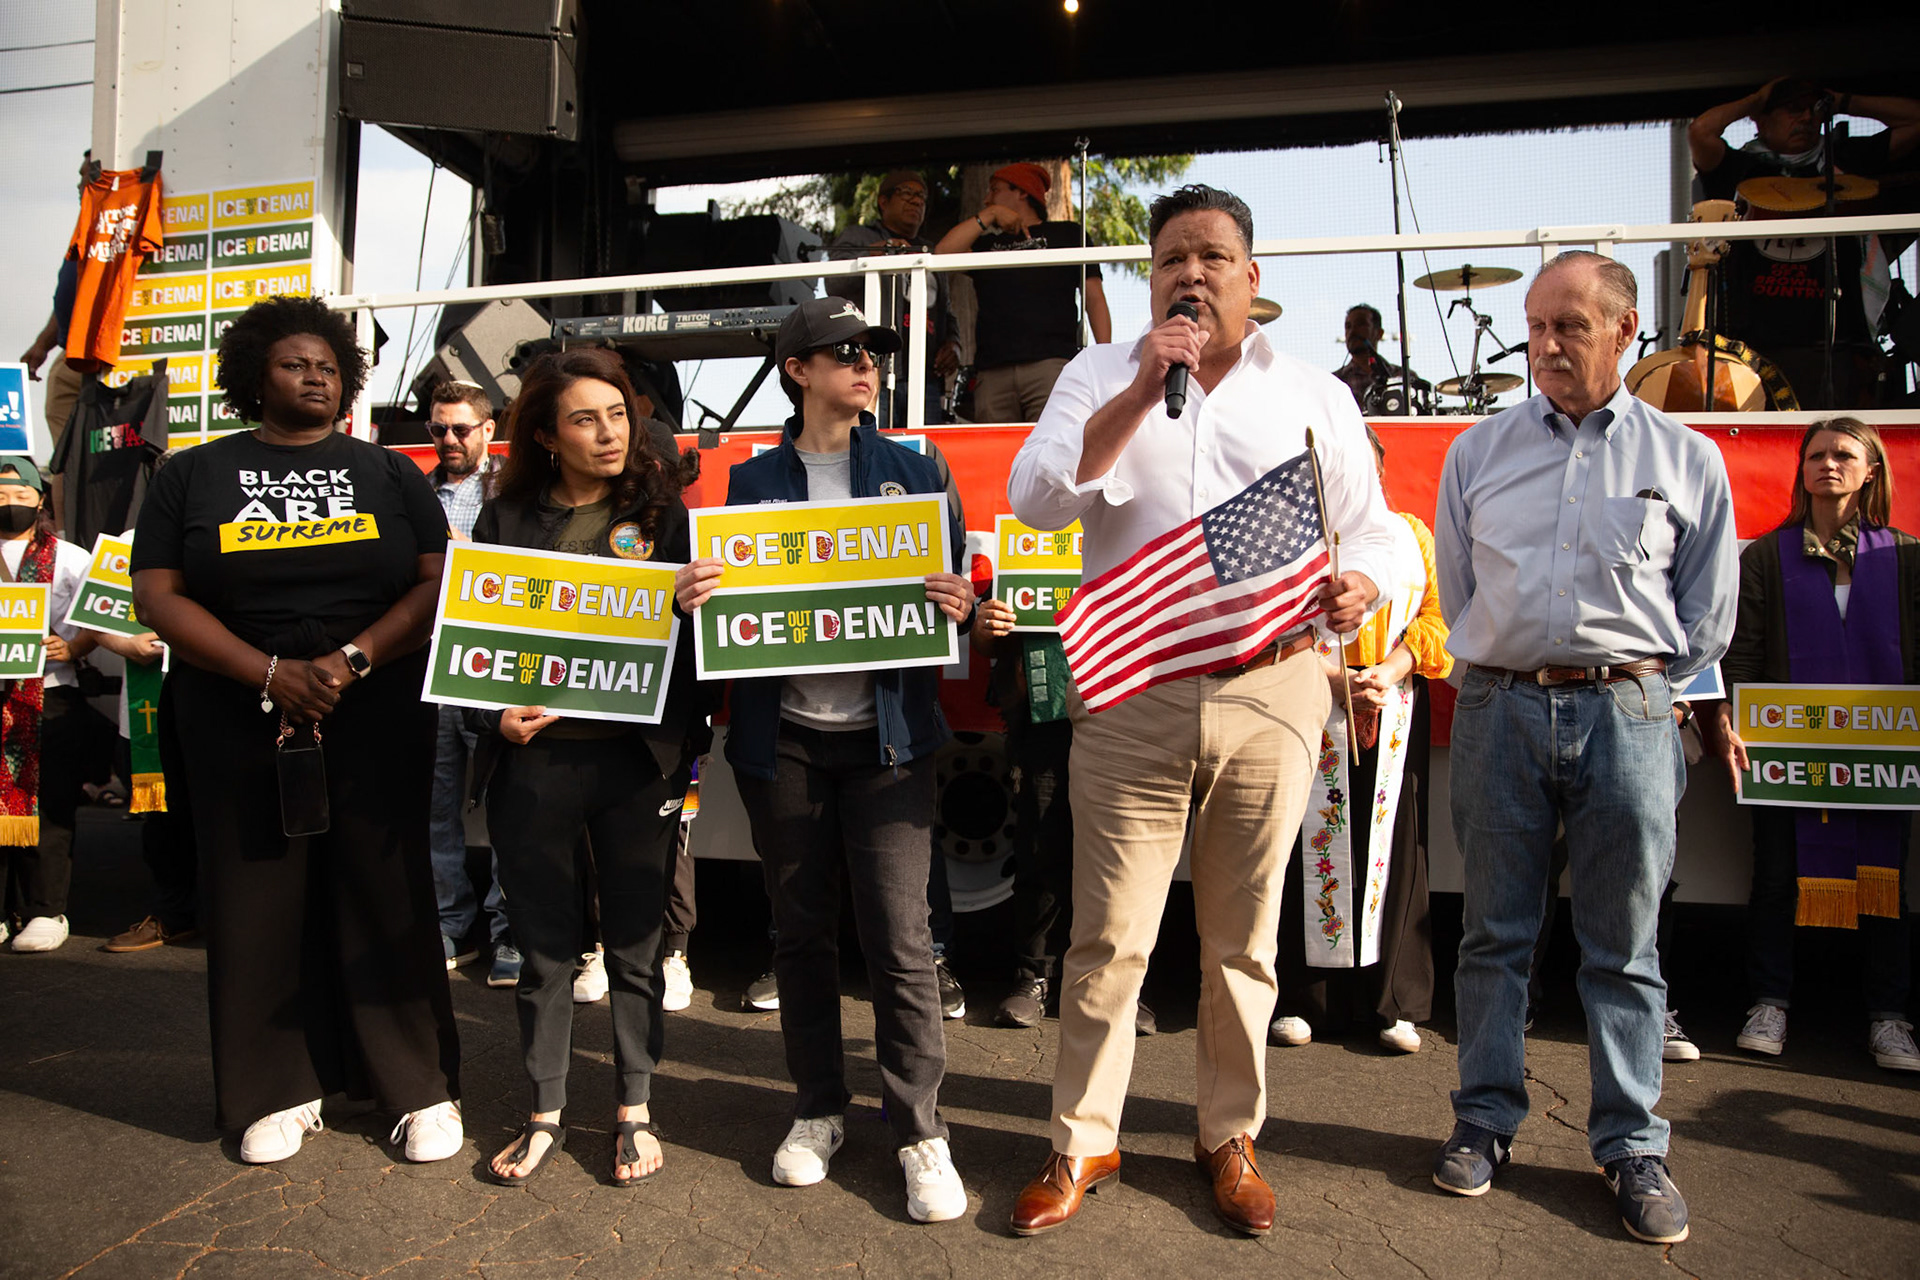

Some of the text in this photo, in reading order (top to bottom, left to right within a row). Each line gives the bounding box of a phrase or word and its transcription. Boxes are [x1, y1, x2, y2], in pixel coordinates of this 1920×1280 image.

[163, 204, 205, 225] ENA!
[217, 199, 247, 218] ICE
[257, 192, 309, 214] DENA!
[217, 238, 247, 257] ICE
[257, 231, 309, 254] DENA!
[152, 284, 204, 306] DENA!
[215, 280, 245, 300] ICE
[255, 274, 308, 297] DENA!
[1750, 284, 1825, 299] OUNTRY
[120, 328, 142, 346] CE
[151, 322, 203, 345] DENA!
[623, 314, 669, 334] KORG
[676, 313, 711, 323] TRITON
[90, 426, 112, 454] ICE
[238, 468, 352, 486] BLACK
[240, 485, 354, 499] WOMEN
[232, 496, 357, 523] ARE
[237, 518, 367, 542] SUPREME
[1054, 533, 1071, 544] OUT
[711, 522, 929, 567] ICE OUT OF DENA!
[1007, 532, 1053, 556] ICE
[1057, 544, 1068, 556] OF
[100, 551, 130, 575] IC
[84, 592, 130, 620] ICE
[459, 569, 667, 621] ICE OUT OF DENA!
[1006, 587, 1053, 610] ICE
[1054, 587, 1071, 599] OUT
[716, 601, 936, 648] ICE OUT OF DENA!
[448, 644, 654, 694] ICE OUT OF DENA!
[1749, 703, 1805, 729] ICE
[1805, 705, 1826, 717] OUT
[1809, 718, 1822, 729] OF
[1751, 760, 1807, 785] ICE
[1807, 762, 1827, 774] OUT
[1811, 774, 1824, 786] OF
